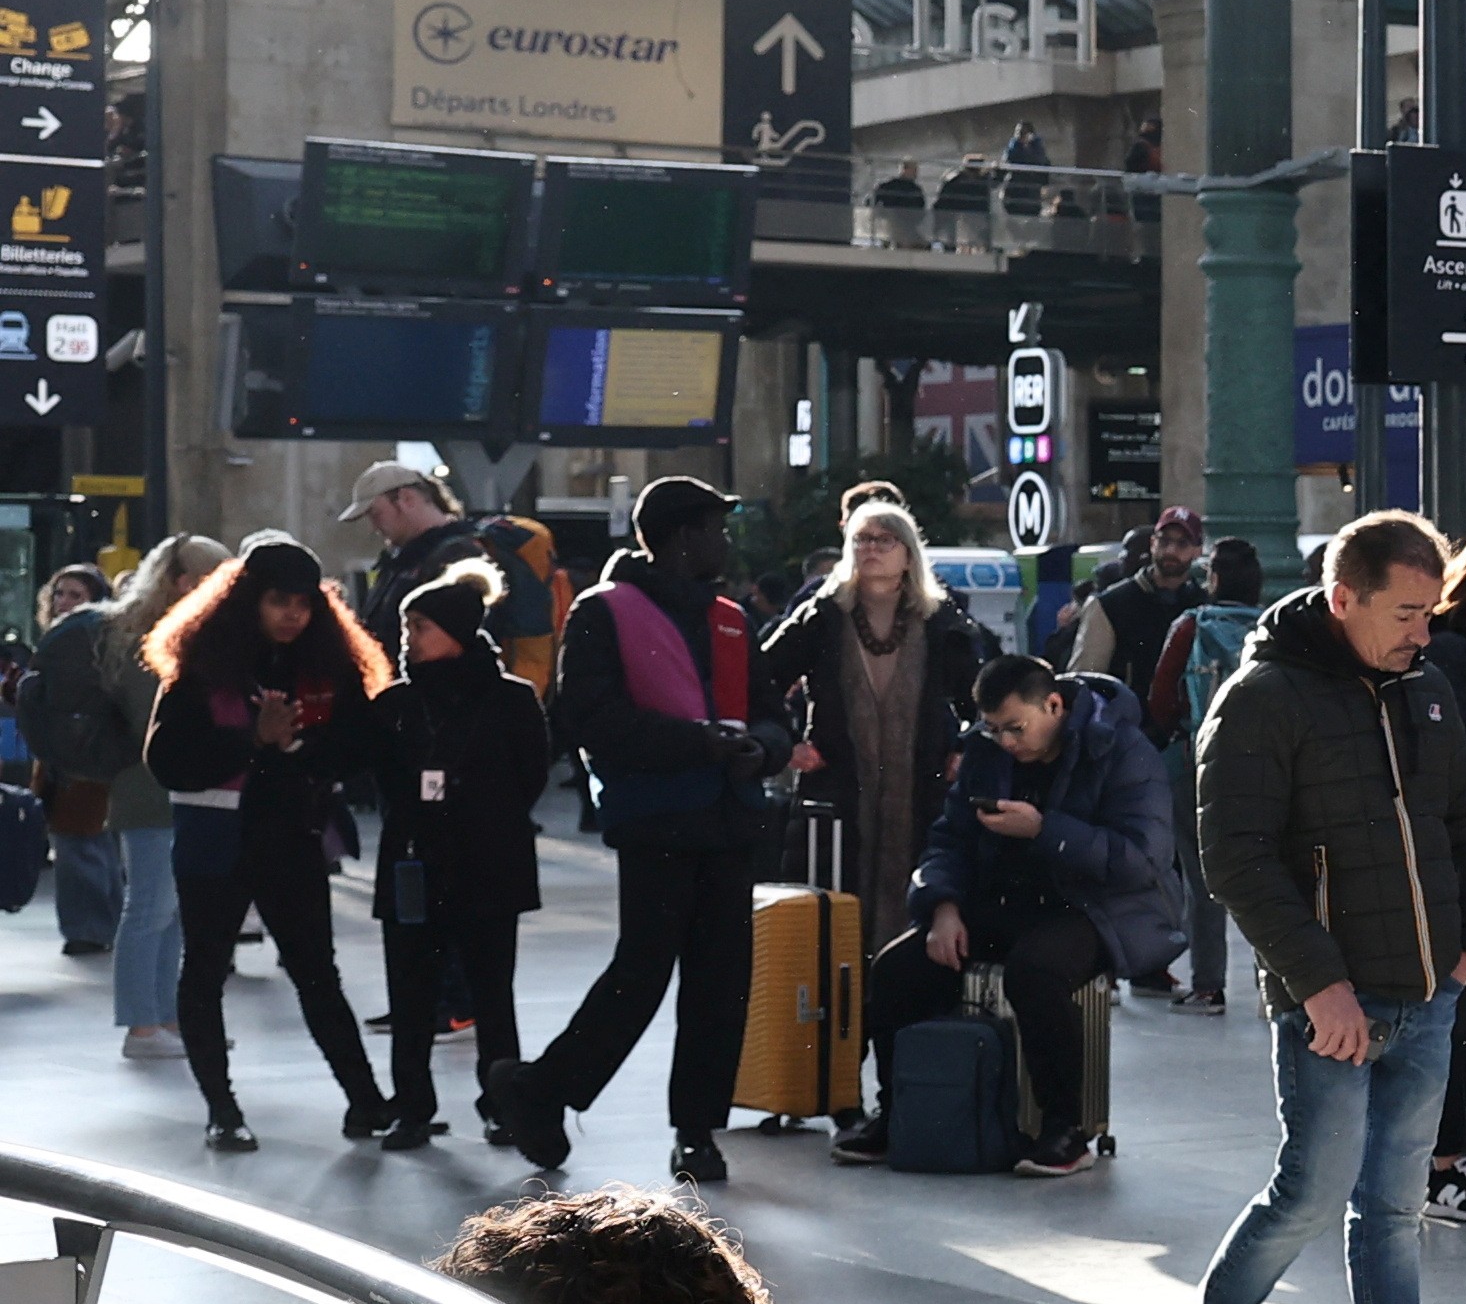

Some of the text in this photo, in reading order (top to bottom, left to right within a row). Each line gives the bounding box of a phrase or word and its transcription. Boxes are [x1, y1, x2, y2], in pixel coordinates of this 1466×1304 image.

[487, 23, 679, 63] eurostar
[10, 57, 73, 79] Change
[411, 85, 617, 124] Départs Londres
[0, 244, 84, 265] Billetteries
[1436, 279, 1453, 291] Lift
[1018, 491, 1041, 536] M
